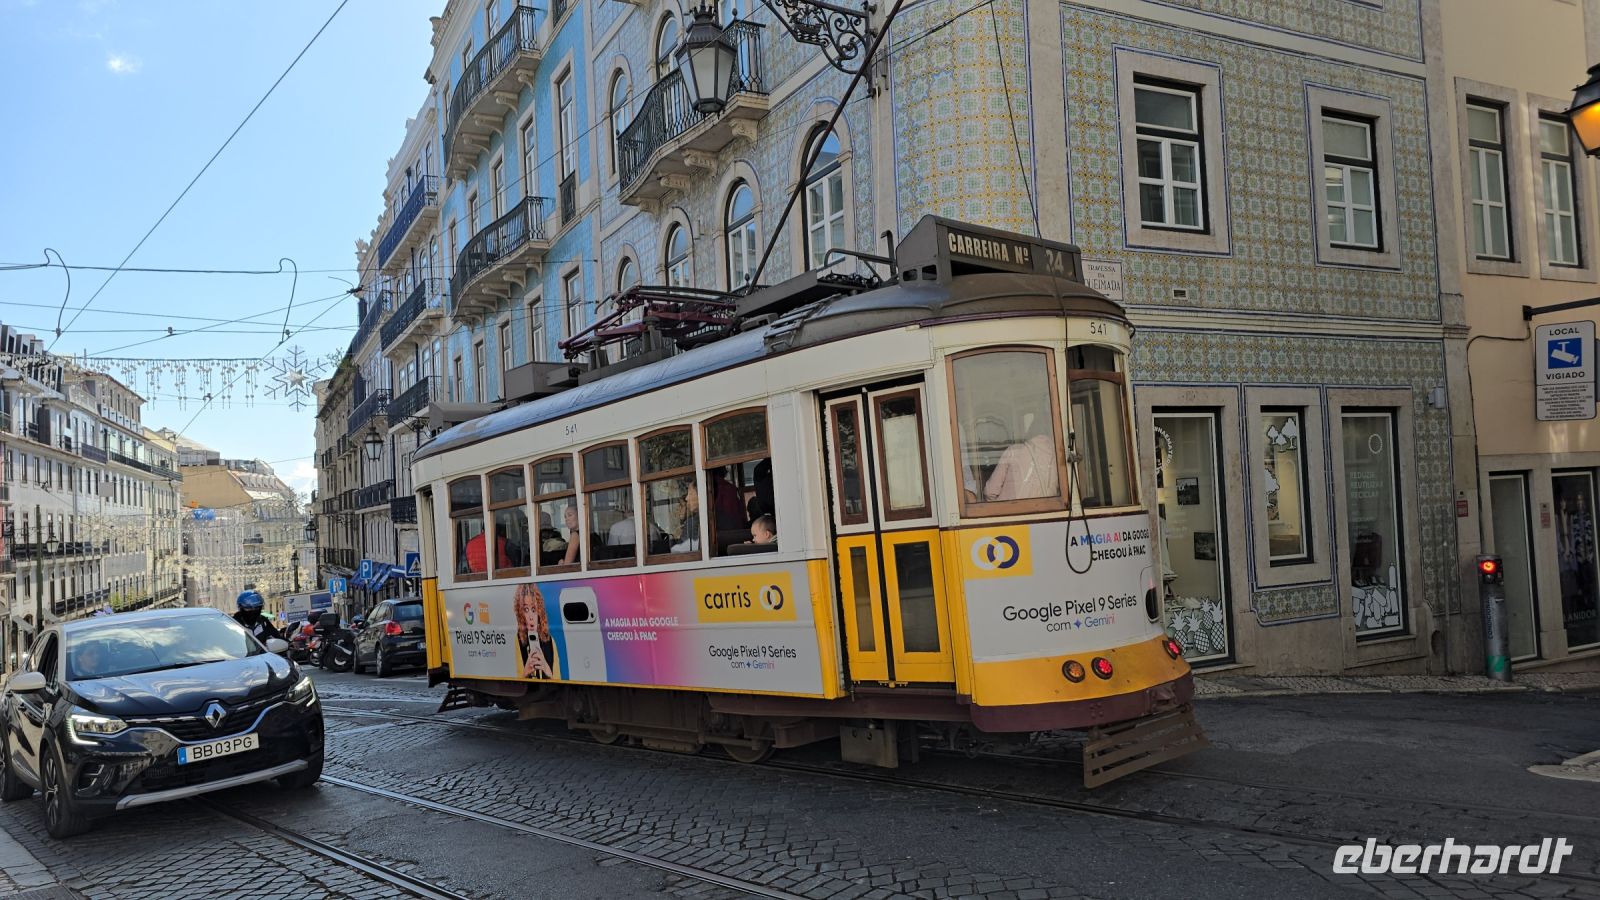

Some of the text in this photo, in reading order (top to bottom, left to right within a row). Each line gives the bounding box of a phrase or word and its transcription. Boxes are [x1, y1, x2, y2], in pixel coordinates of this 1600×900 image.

[947, 232, 1010, 263] CARREIRA
[1014, 245, 1029, 265] Nº
[1088, 264, 1116, 273] TRAVESSA
[1090, 321, 1107, 336] 541
[1549, 327, 1580, 336] LOCAL
[1545, 371, 1586, 380] VIGIADO
[565, 423, 578, 436] 541
[1070, 536, 1078, 547] A
[1080, 532, 1112, 546] MAGIA
[1113, 531, 1122, 543] AI
[1122, 531, 1132, 541] DA
[1091, 544, 1147, 561] CHEGOU À FNAC
[704, 584, 752, 610] carris
[1003, 593, 1137, 622] Google Pixel 9 Series
[604, 618, 610, 627] A
[610, 617, 632, 627] MAGIA
[639, 617, 648, 627] DA
[649, 616, 679, 627] GOOGLE
[1046, 613, 1116, 632] com Gemini
[455, 630, 506, 645] Pixel 9 Series
[607, 631, 633, 641] CHEGOU
[640, 631, 657, 641] FNAC
[482, 649, 497, 658] Gemini
[708, 644, 797, 660] Google Pixel 9 Series
[731, 660, 775, 669] com Gemini
